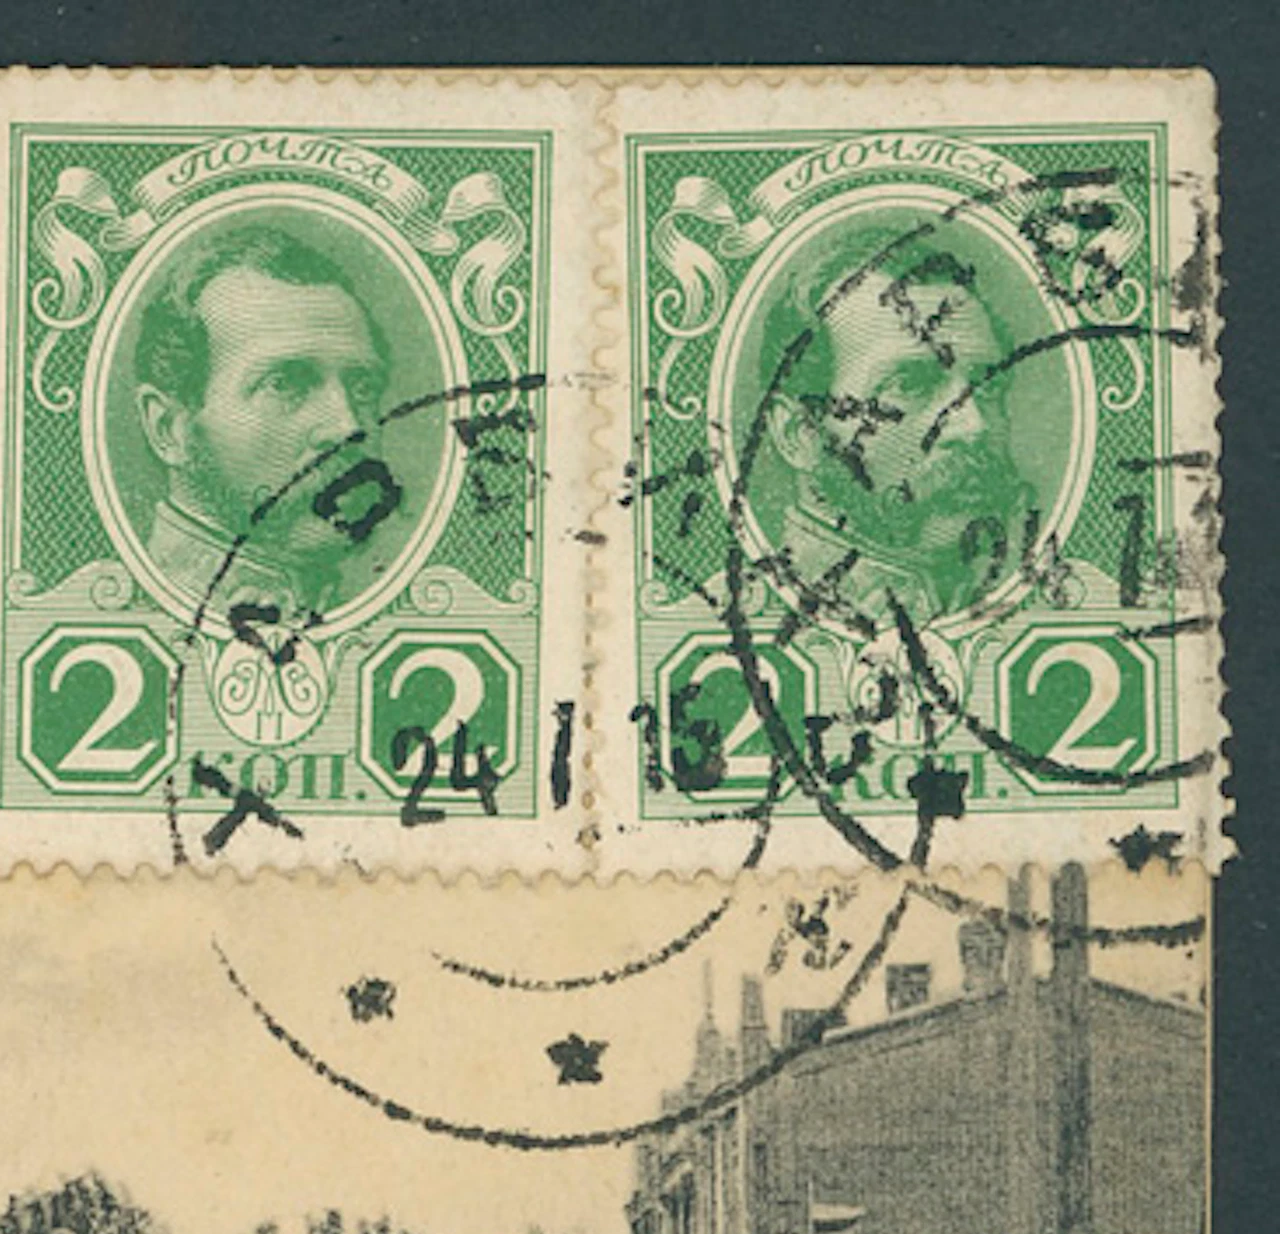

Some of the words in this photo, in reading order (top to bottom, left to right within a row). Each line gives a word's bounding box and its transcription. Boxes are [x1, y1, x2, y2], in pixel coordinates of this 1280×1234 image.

[166, 135, 392, 188] ПОЧТА
[783, 136, 1011, 192] ПОЧТА
[49, 641, 159, 772] 2
[388, 646, 499, 778] 2
[1026, 640, 1138, 772] 2
